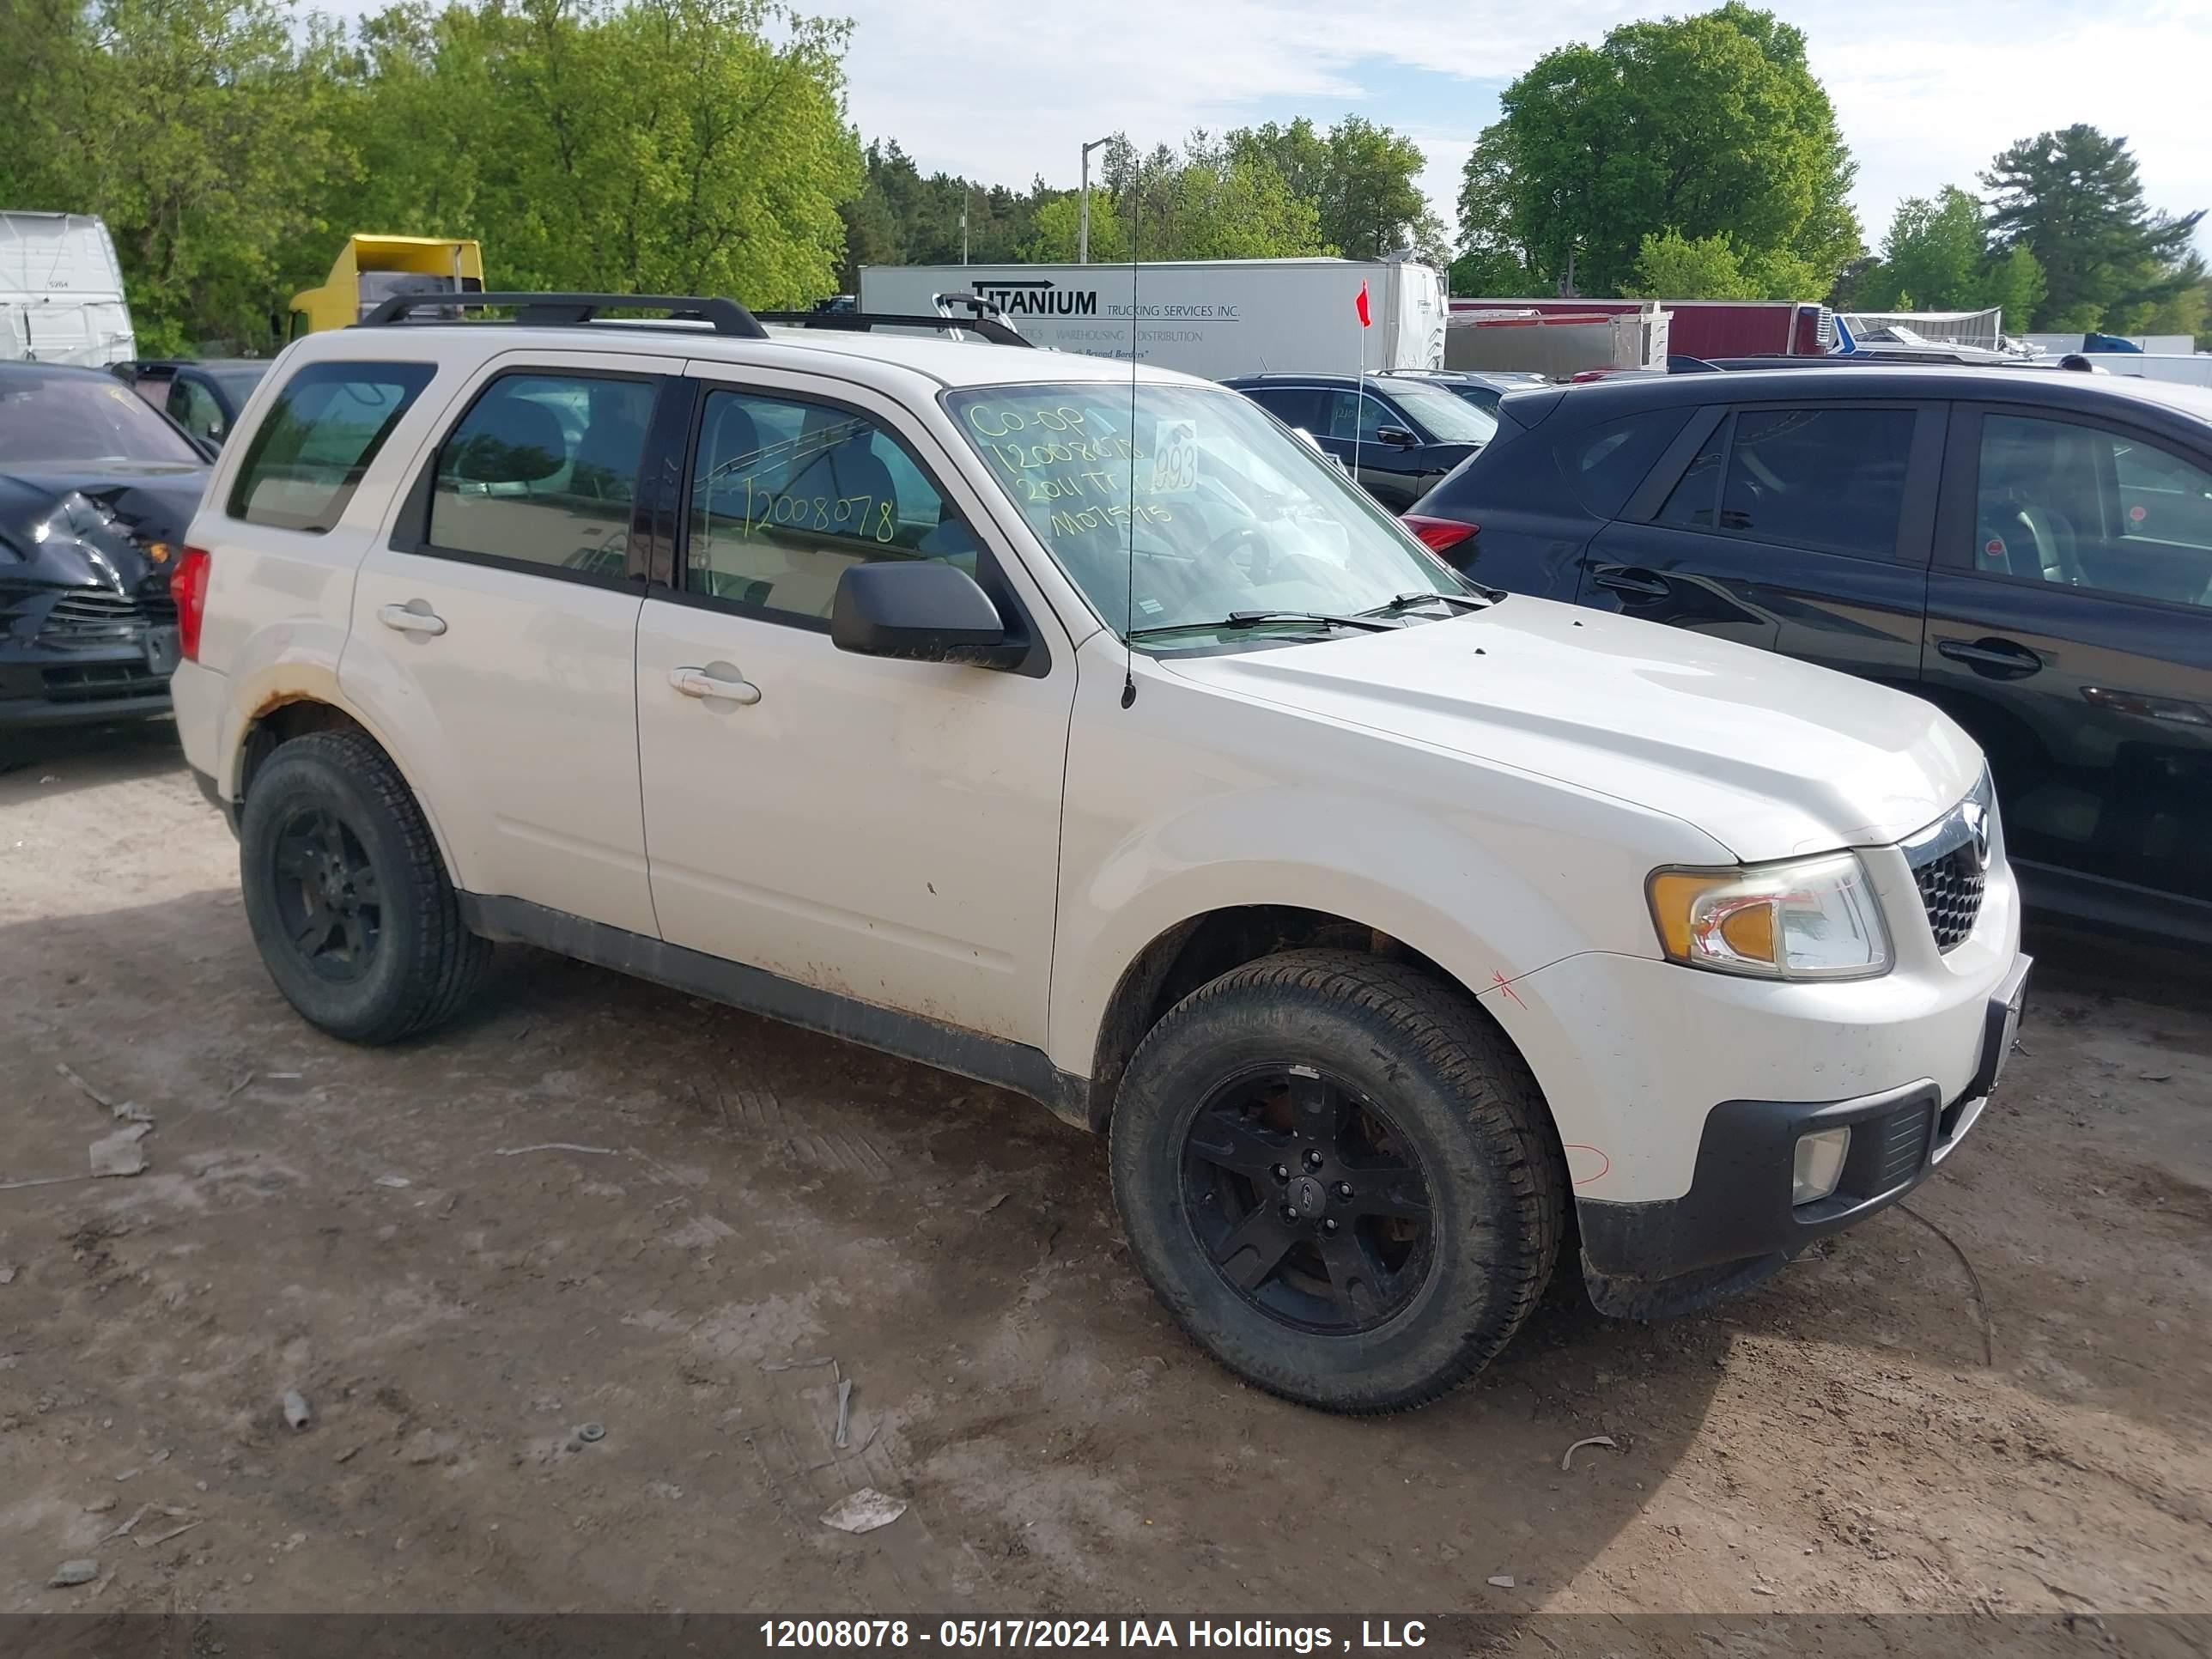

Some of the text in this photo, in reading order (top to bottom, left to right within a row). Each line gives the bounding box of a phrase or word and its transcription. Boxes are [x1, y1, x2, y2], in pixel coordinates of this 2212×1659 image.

[971, 280, 1241, 319] TITANIUM TRUCKING SERVICES INC.
[1056, 329, 1125, 341] WAREHOUSING
[1137, 331, 1202, 343] DISTRIBUTION
[742, 477, 894, 543] 12008078
